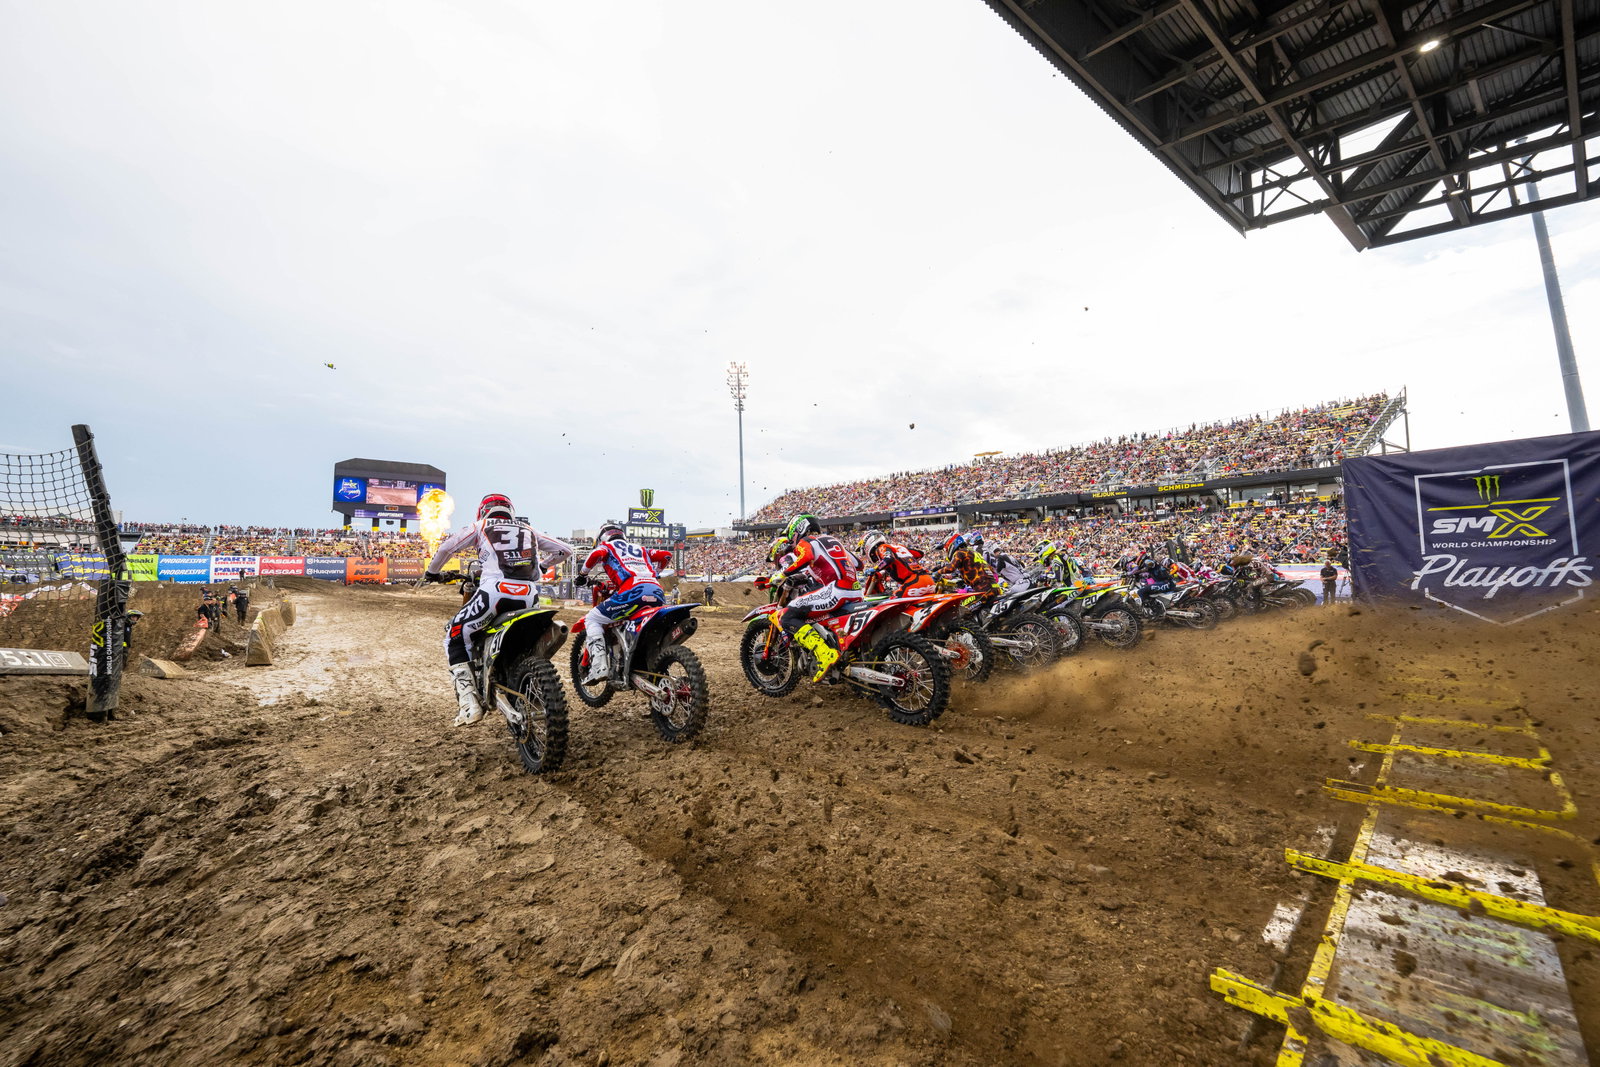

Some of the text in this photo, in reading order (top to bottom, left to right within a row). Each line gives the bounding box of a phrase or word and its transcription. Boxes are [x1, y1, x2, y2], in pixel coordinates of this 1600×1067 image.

[1158, 484, 1190, 492] SCHMID
[632, 510, 661, 523] SMX
[1430, 505, 1552, 539] SMX
[492, 526, 532, 551] 31
[626, 526, 669, 538] FINISH
[613, 540, 643, 558] 96
[1432, 538, 1557, 549] WORLD CHAMPIONSHIP
[503, 551, 522, 559] 5.11
[1411, 553, 1594, 600] Playoffs
[815, 596, 839, 610] DUCATI
[1085, 596, 1097, 606] 20
[454, 594, 486, 623] FXR
[0, 650, 52, 667] 5.11
